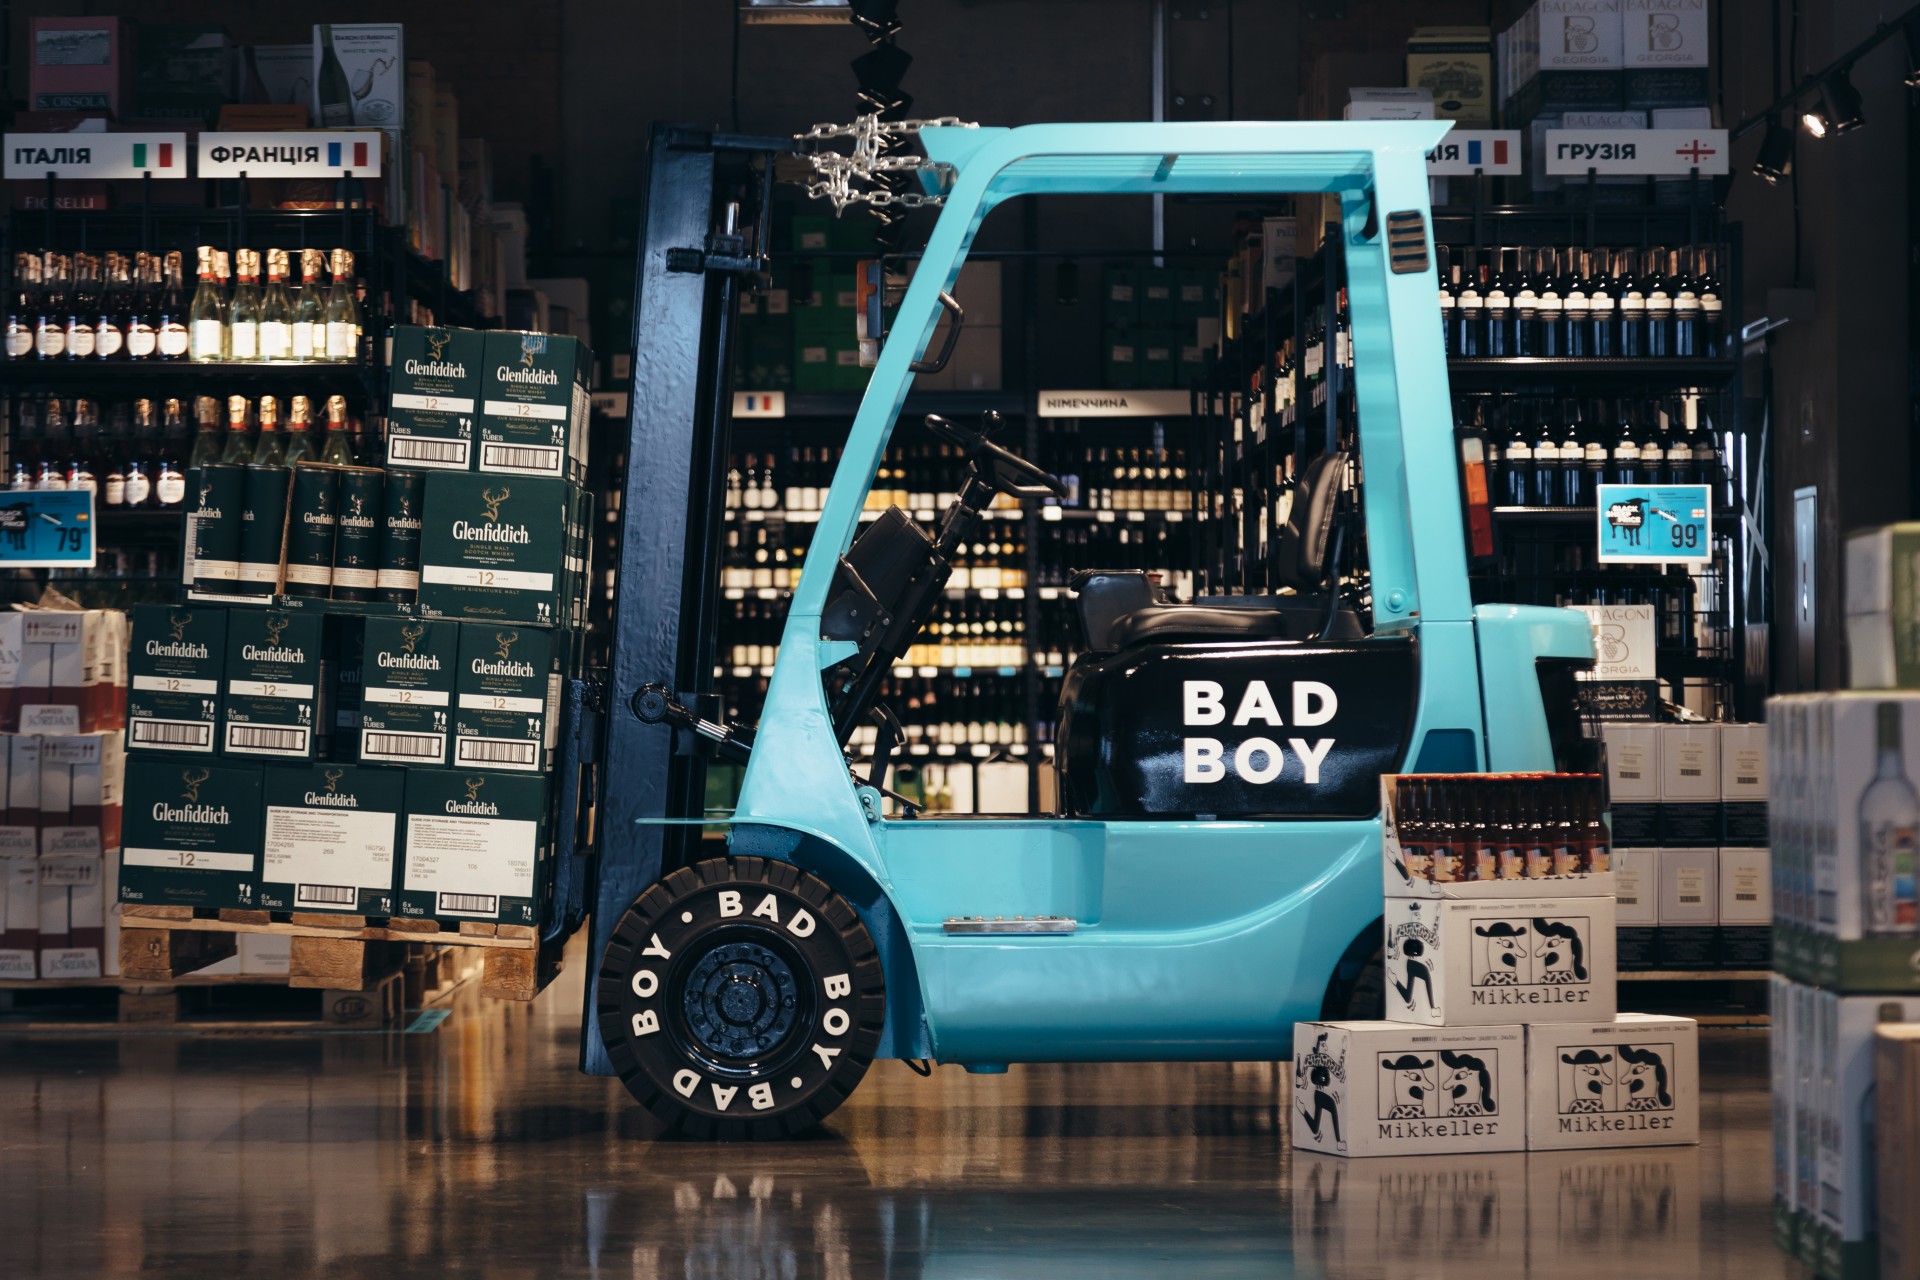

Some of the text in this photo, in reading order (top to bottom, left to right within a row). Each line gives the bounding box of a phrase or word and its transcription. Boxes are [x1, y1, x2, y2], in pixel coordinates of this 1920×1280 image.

[1552, 56, 1609, 64] GEORGIA
[1637, 53, 1694, 62] GEORGIA
[53, 94, 107, 107] ORSOLA
[15, 147, 91, 164] ІТАЛІЯ
[210, 146, 319, 165] ФРАНЦІЯ
[1557, 143, 1636, 160] ГРУЗІЯ
[405, 359, 466, 378] Glenfiddich
[497, 366, 558, 385] Glenfiddich
[425, 398, 438, 408] 12
[517, 405, 530, 416] 12
[340, 515, 374, 528] Glenfiddich
[55, 527, 82, 552] 79
[452, 520, 528, 544] Glenfiddich
[1672, 524, 1697, 548] 99
[478, 572, 494, 585] 12
[282, 600, 302, 608] TUBES
[146, 640, 208, 658] Glenfiddich
[242, 644, 304, 664] Glenfiddich
[378, 652, 439, 670] Glenfiddich
[472, 658, 534, 678] Glenfiddich
[166, 680, 180, 690] 12
[264, 684, 276, 696] 12
[398, 692, 412, 702] 12
[492, 698, 506, 708] 12
[1183, 680, 1338, 726] BAD
[457, 728, 478, 736] TUBES
[1184, 736, 1336, 784] BOY
[304, 792, 357, 807] Glenfiddich
[446, 800, 498, 816] Glenfiddich
[152, 802, 228, 824] Glenfiddich
[179, 852, 195, 866] 12
[718, 890, 816, 938] BAD
[632, 932, 672, 1036] BOY
[1471, 987, 1590, 1006] Mikkeller
[812, 973, 852, 1071] BOY
[672, 1068, 775, 1112] BAD
[1378, 1120, 1498, 1139] Mikkeller
[1558, 1114, 1674, 1132] Mikkeller
